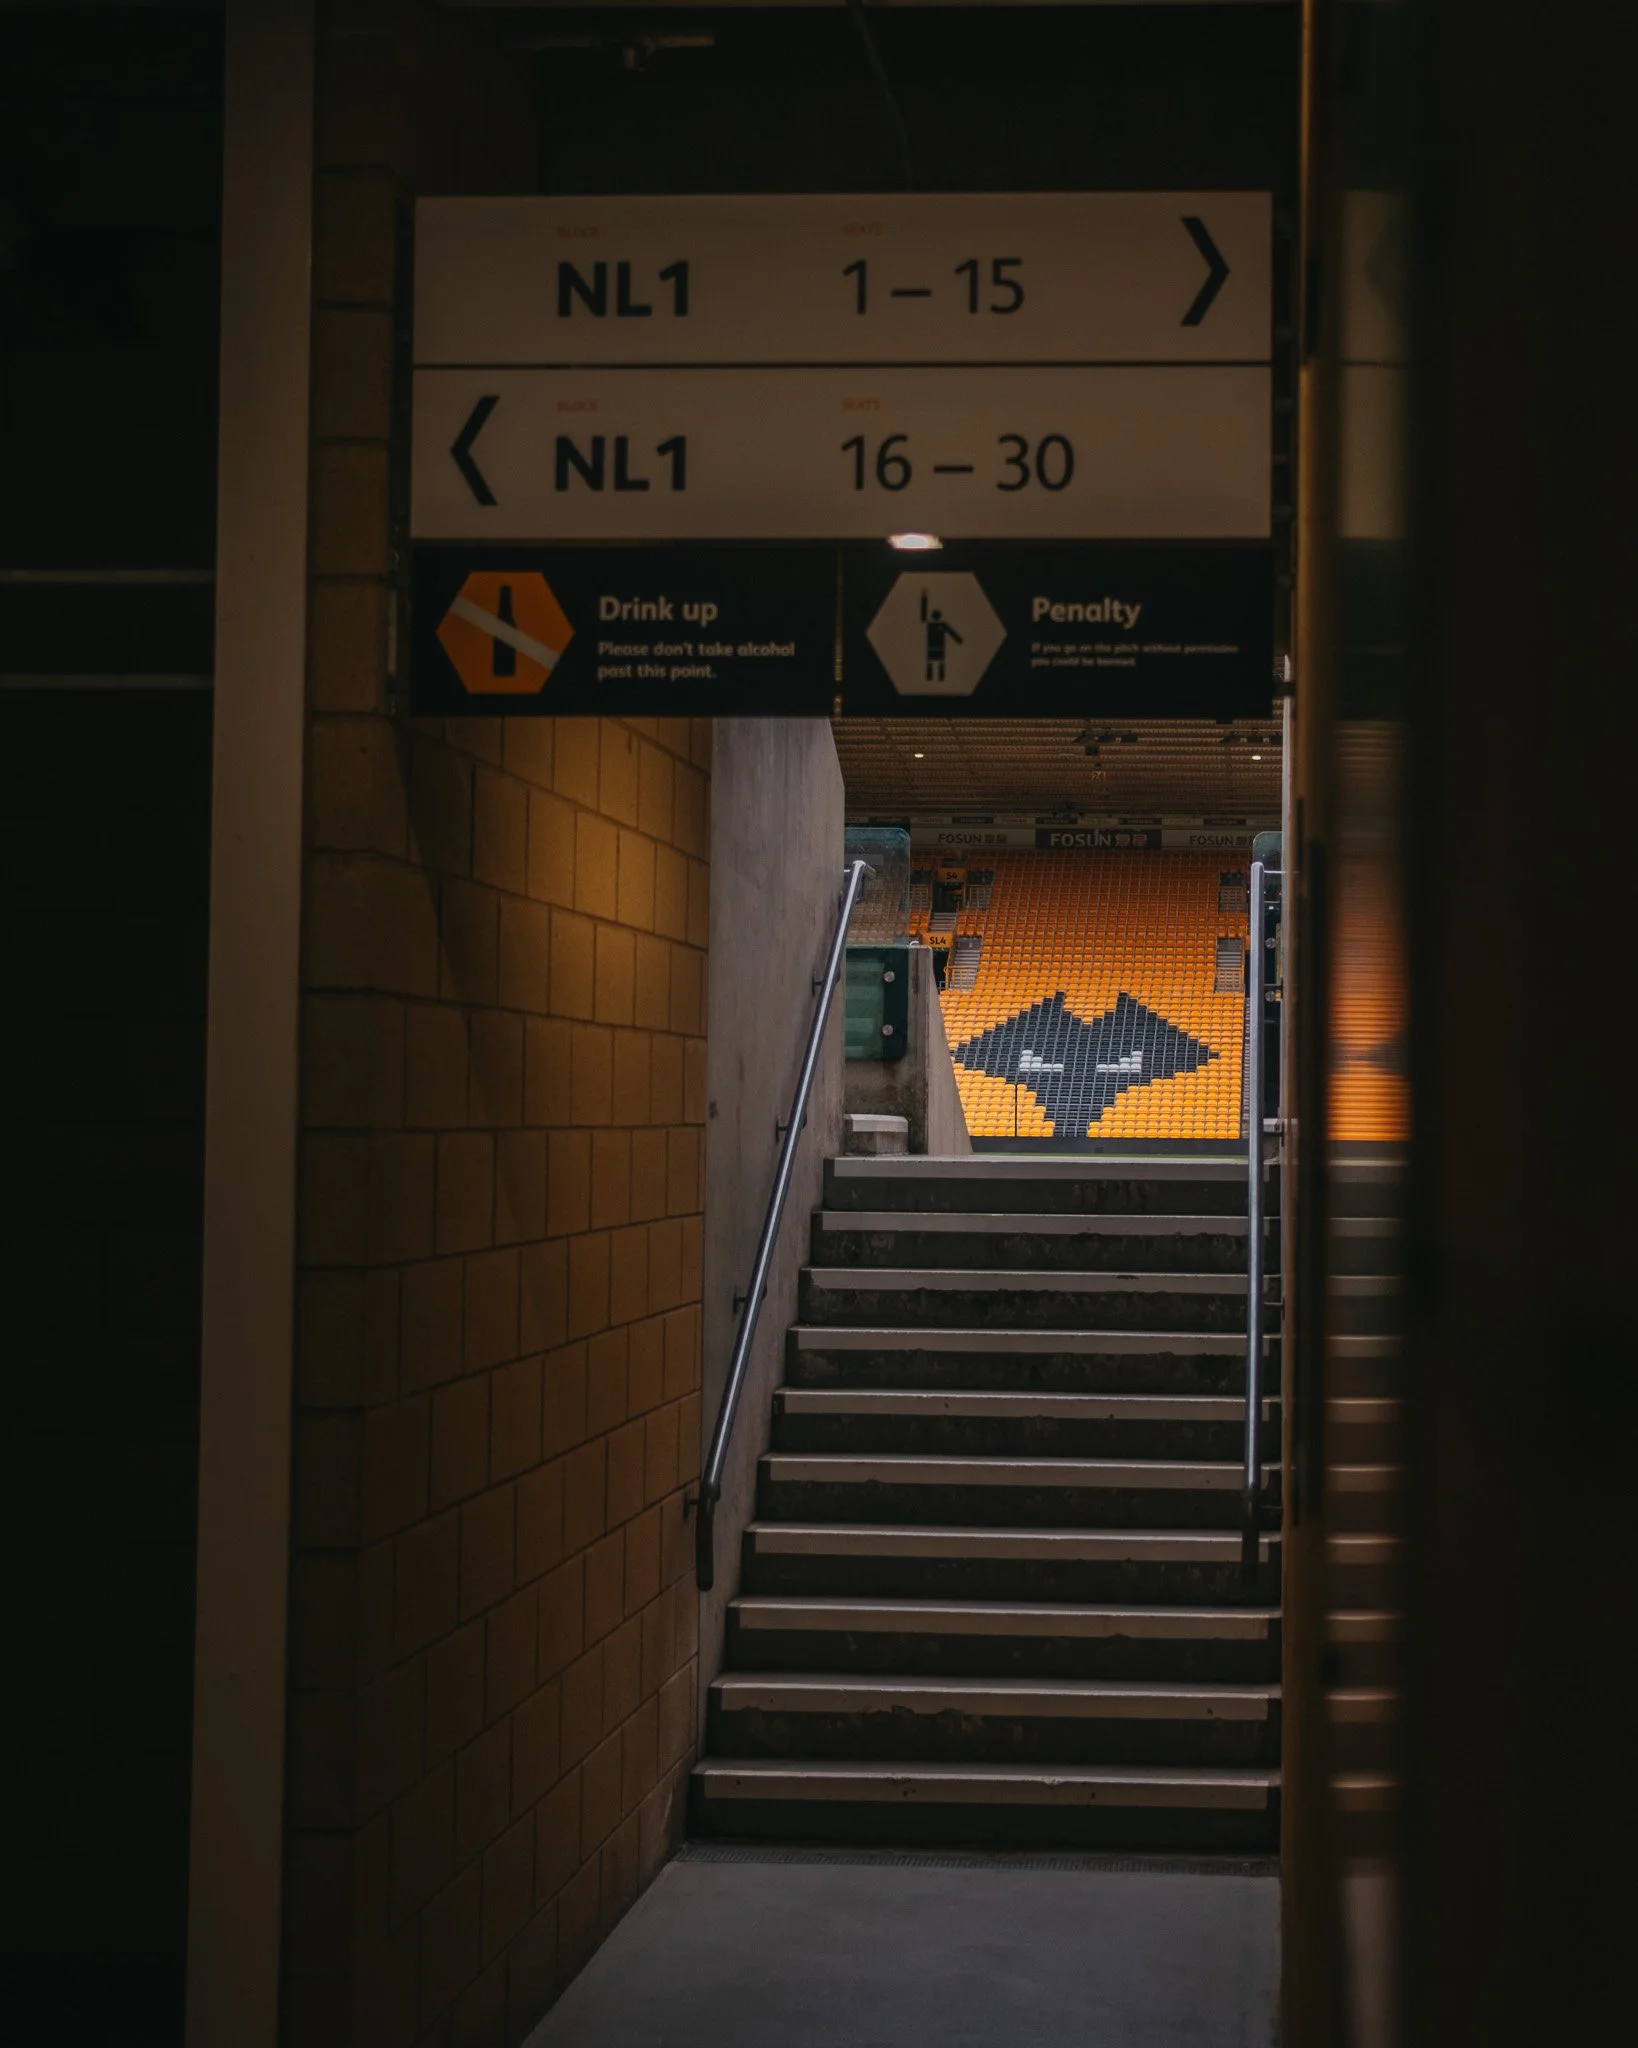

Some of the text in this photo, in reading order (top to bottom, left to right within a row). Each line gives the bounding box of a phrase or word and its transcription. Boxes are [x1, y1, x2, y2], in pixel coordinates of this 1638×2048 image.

[557, 260, 689, 317] NL1
[842, 258, 866, 315] 1
[954, 257, 1025, 315] 15
[555, 435, 687, 493] NL1
[841, 433, 913, 492] 16
[997, 433, 1075, 493] 30
[598, 596, 719, 627] Drink up
[1032, 596, 1142, 629] Penalty
[598, 641, 795, 656] Please don't take alcohol
[598, 664, 716, 682] past this point.
[938, 833, 982, 844] FOSUN
[1050, 833, 1111, 847] FOSUN
[1190, 835, 1234, 846] FOSUN
[929, 936, 946, 945] SL4
